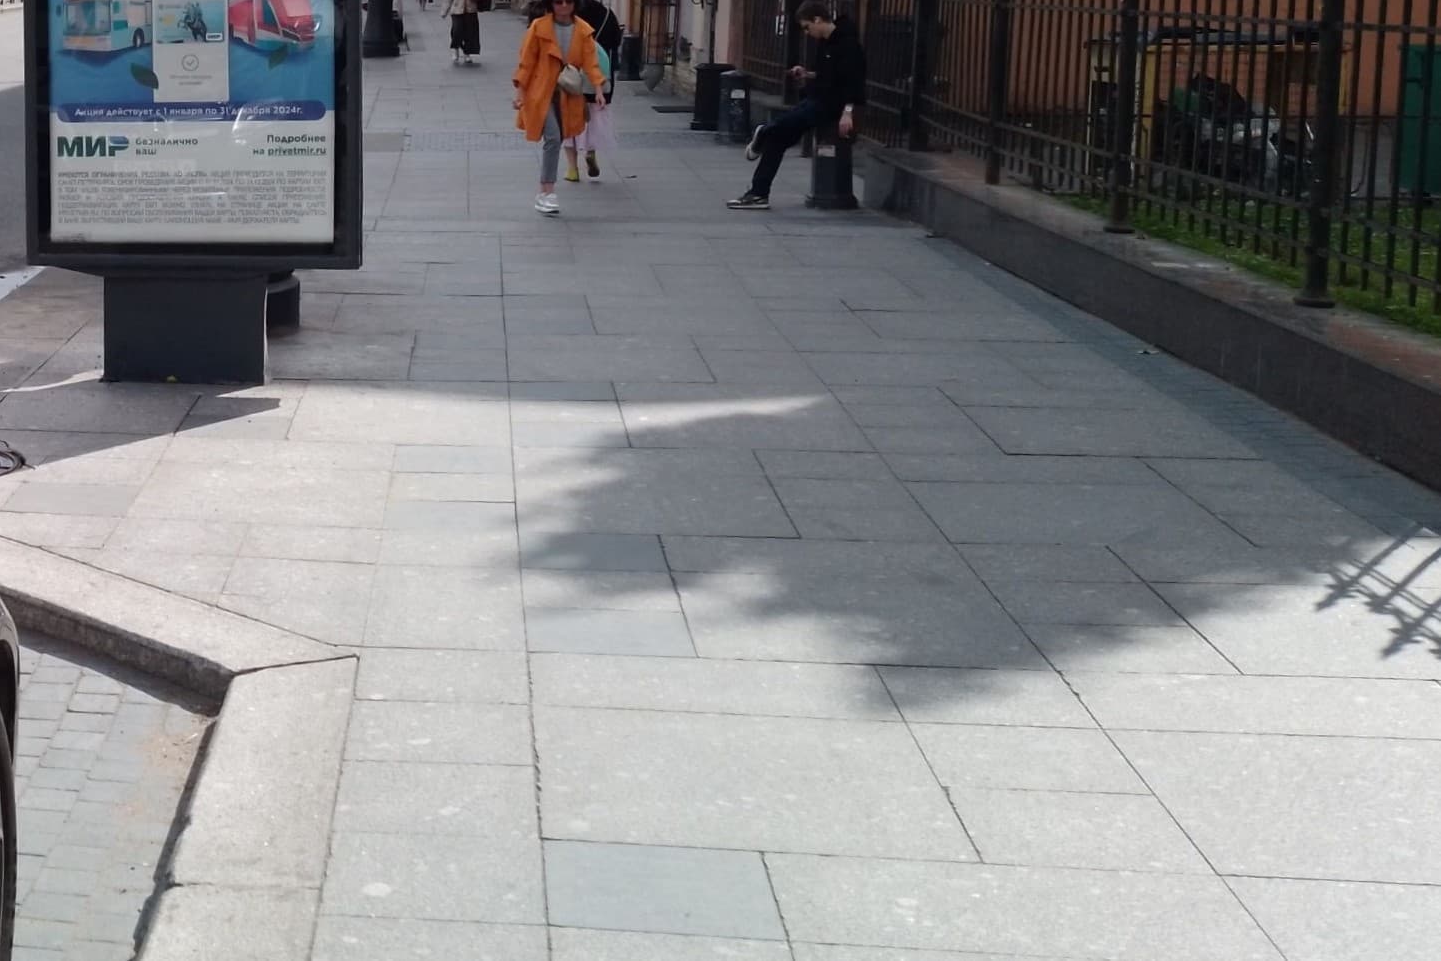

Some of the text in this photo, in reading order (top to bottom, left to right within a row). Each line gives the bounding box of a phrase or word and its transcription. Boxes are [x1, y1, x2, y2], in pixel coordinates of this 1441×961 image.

[266, 134, 326, 144] Подробнее
[57, 136, 129, 157] МИР
[252, 146, 327, 157] на privetmir.ru
[135, 148, 157, 156] ваш
